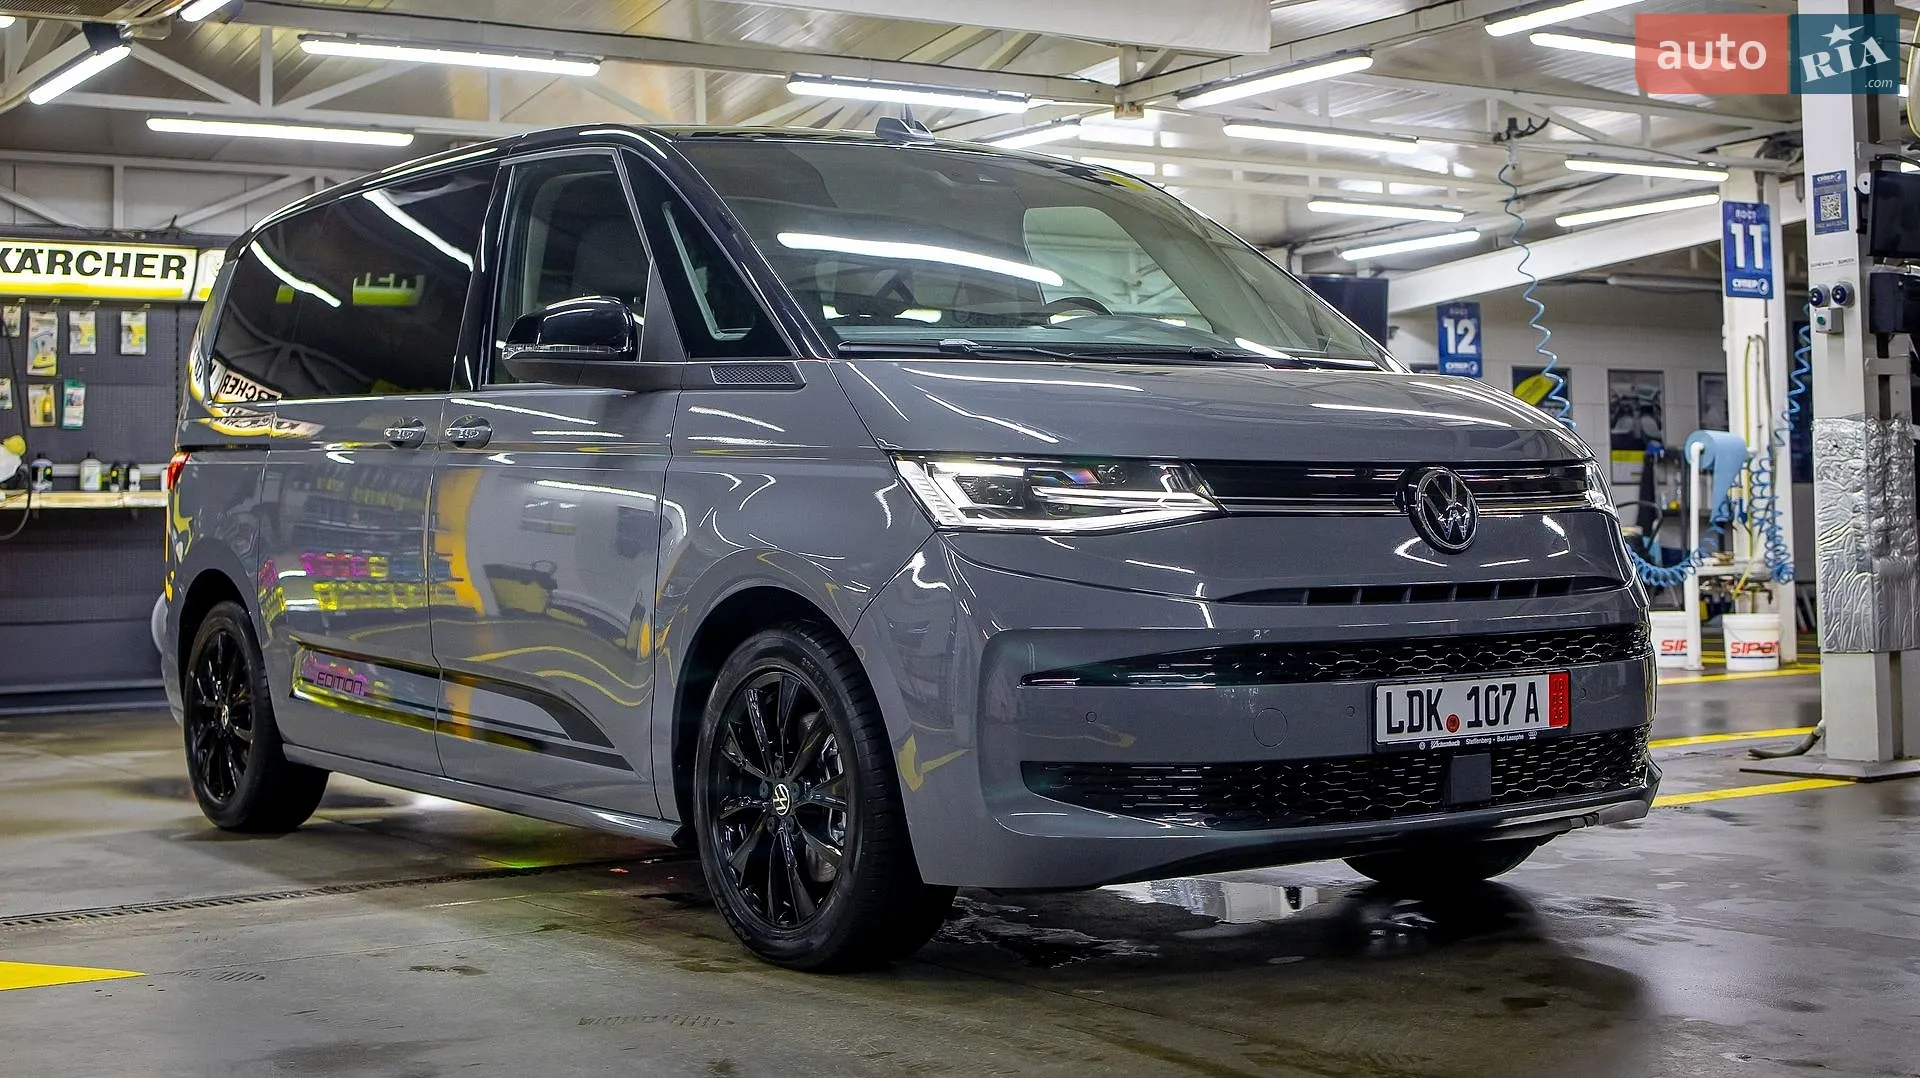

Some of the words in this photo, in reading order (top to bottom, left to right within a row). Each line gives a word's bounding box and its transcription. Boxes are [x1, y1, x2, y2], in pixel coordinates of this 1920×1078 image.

[1731, 223, 1763, 269] 11
[1443, 318, 1477, 354] 12
[317, 671, 363, 695] EDITION
[1386, 688, 1444, 734] LDK
[1467, 683, 1517, 728] 107
[1525, 681, 1540, 723] A
